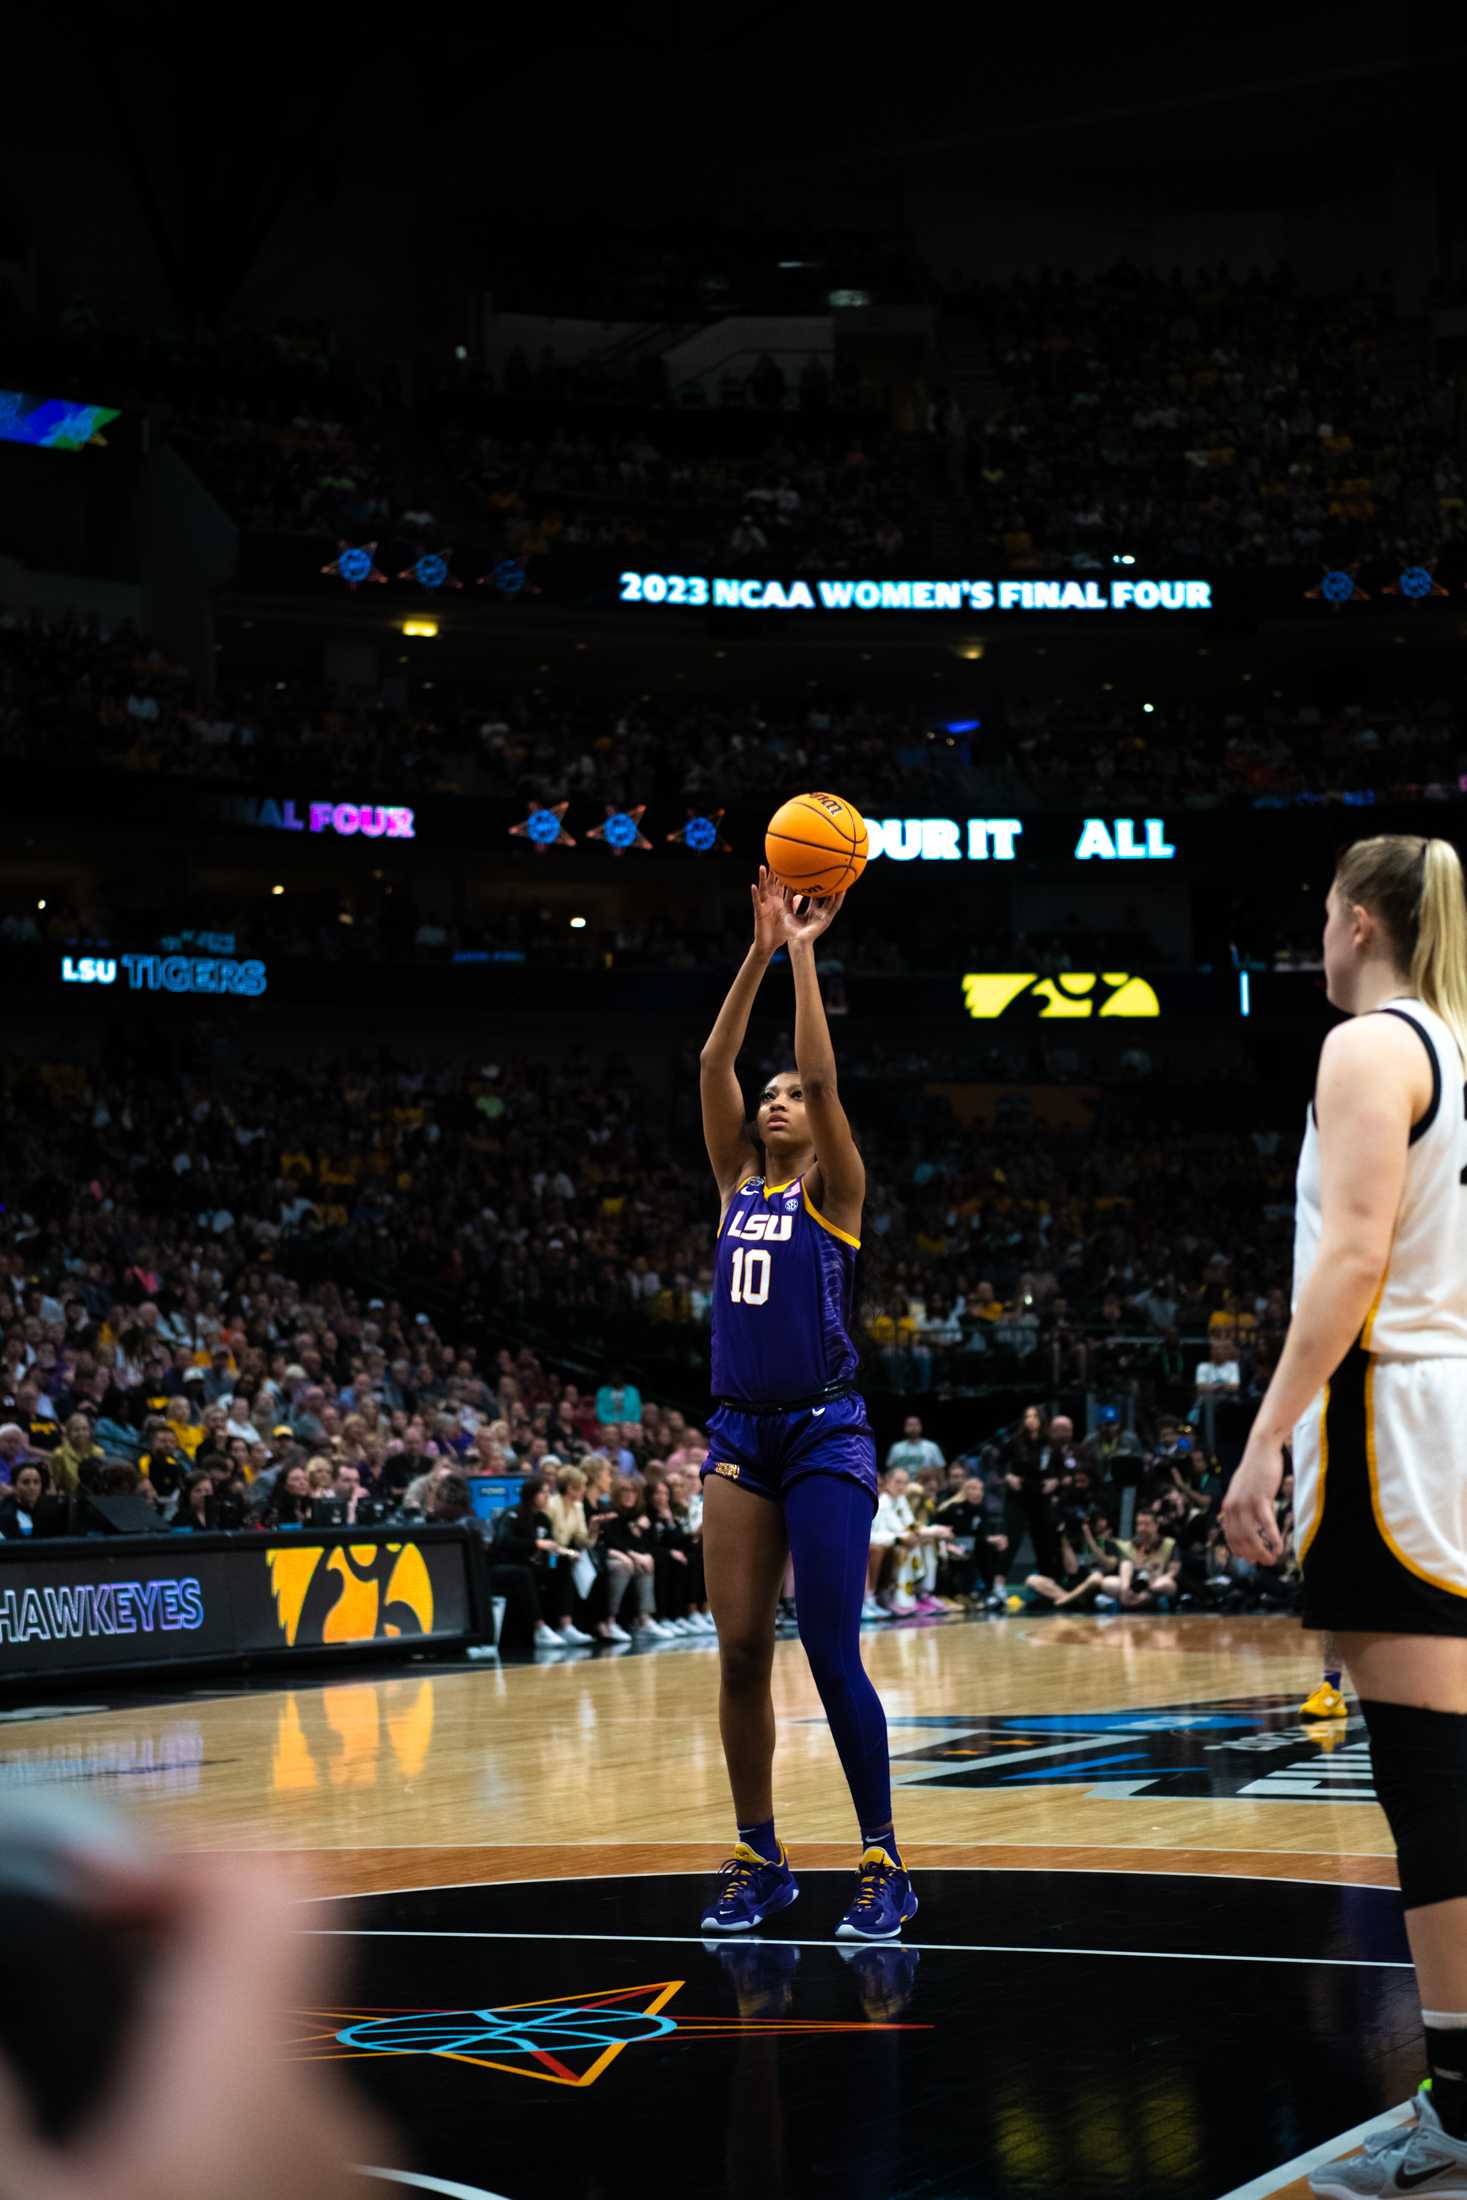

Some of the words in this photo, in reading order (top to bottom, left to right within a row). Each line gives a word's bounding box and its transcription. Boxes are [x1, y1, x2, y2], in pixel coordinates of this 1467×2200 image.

[619, 572, 709, 606] 2023
[712, 577, 816, 609] NCAA
[817, 579, 996, 611] WOMEN'S
[997, 580, 1108, 610] FINAL
[1110, 579, 1213, 610] FOUR
[308, 801, 417, 840] FOUR
[863, 818, 964, 862] OUR
[967, 818, 1024, 861] IT
[1074, 818, 1177, 860] ALL
[60, 955, 118, 985] LSU
[121, 951, 268, 997] TIGERS
[727, 1210, 793, 1242] LSU
[730, 1247, 772, 1306] 10
[0, 1577, 205, 1644] HAWKEYES
